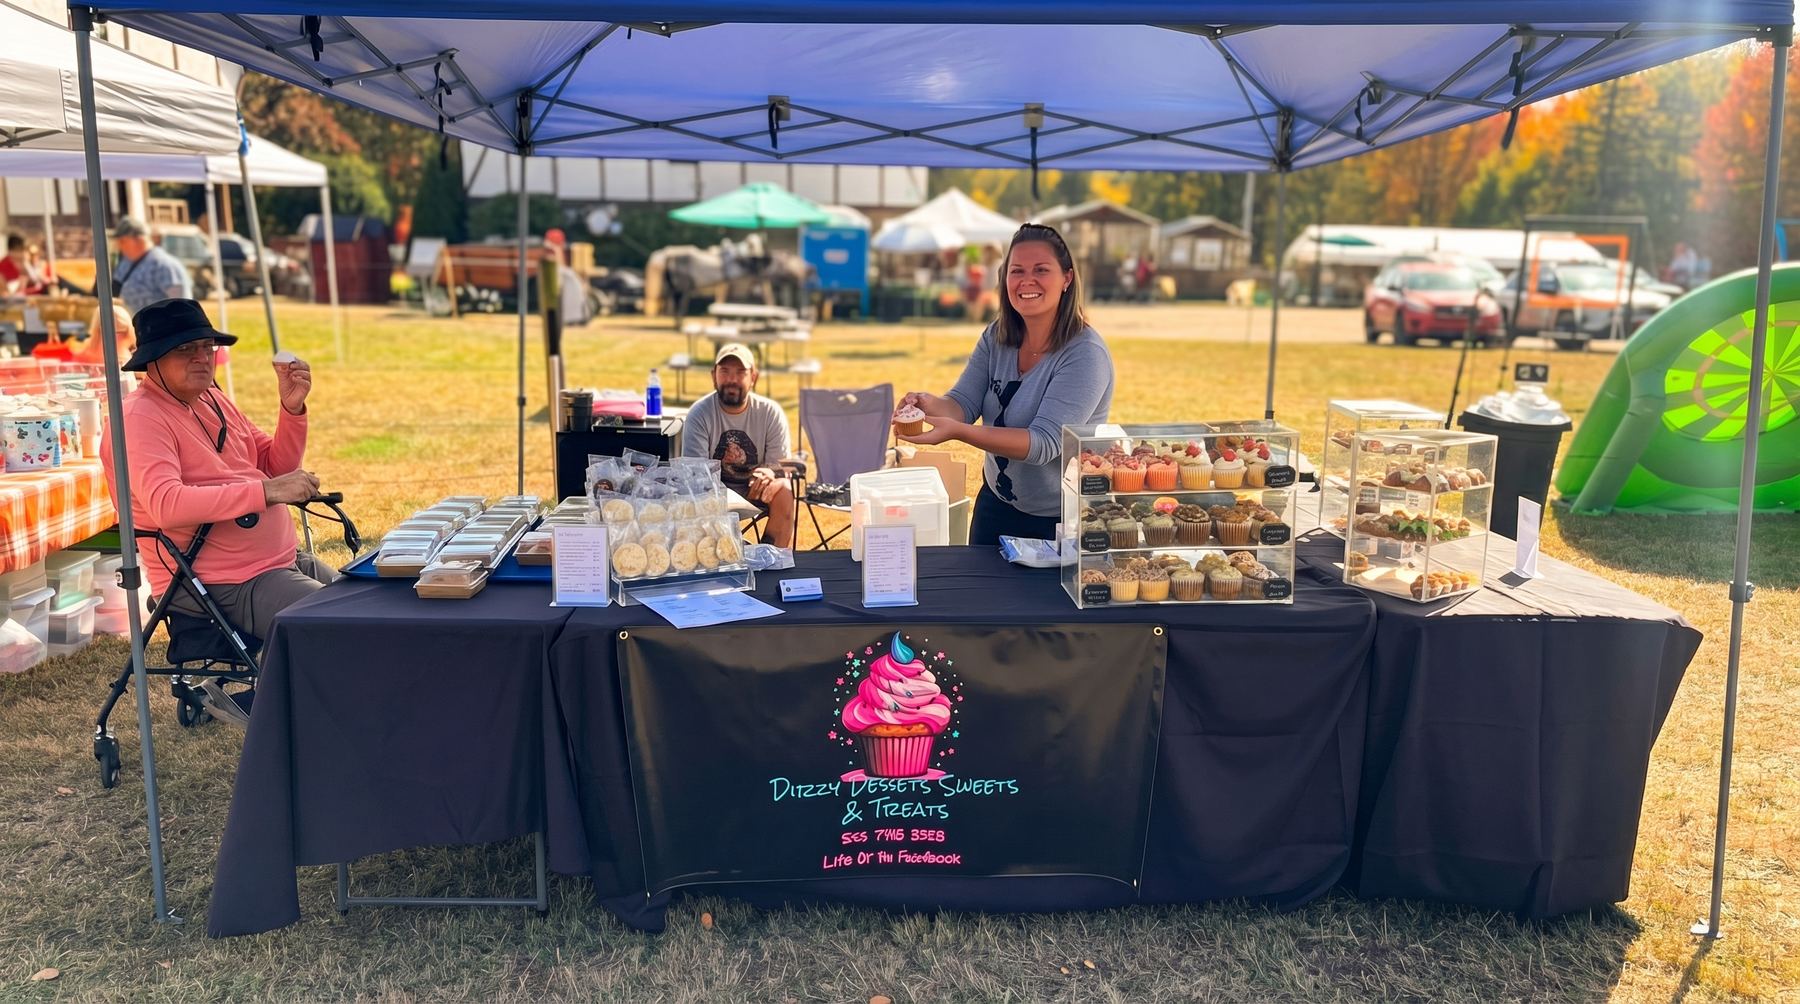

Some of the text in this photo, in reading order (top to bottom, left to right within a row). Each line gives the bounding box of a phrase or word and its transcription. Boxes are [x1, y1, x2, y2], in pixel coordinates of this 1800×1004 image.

[938, 774, 1019, 797] SWEETS
[841, 796, 949, 825] & TREATS
